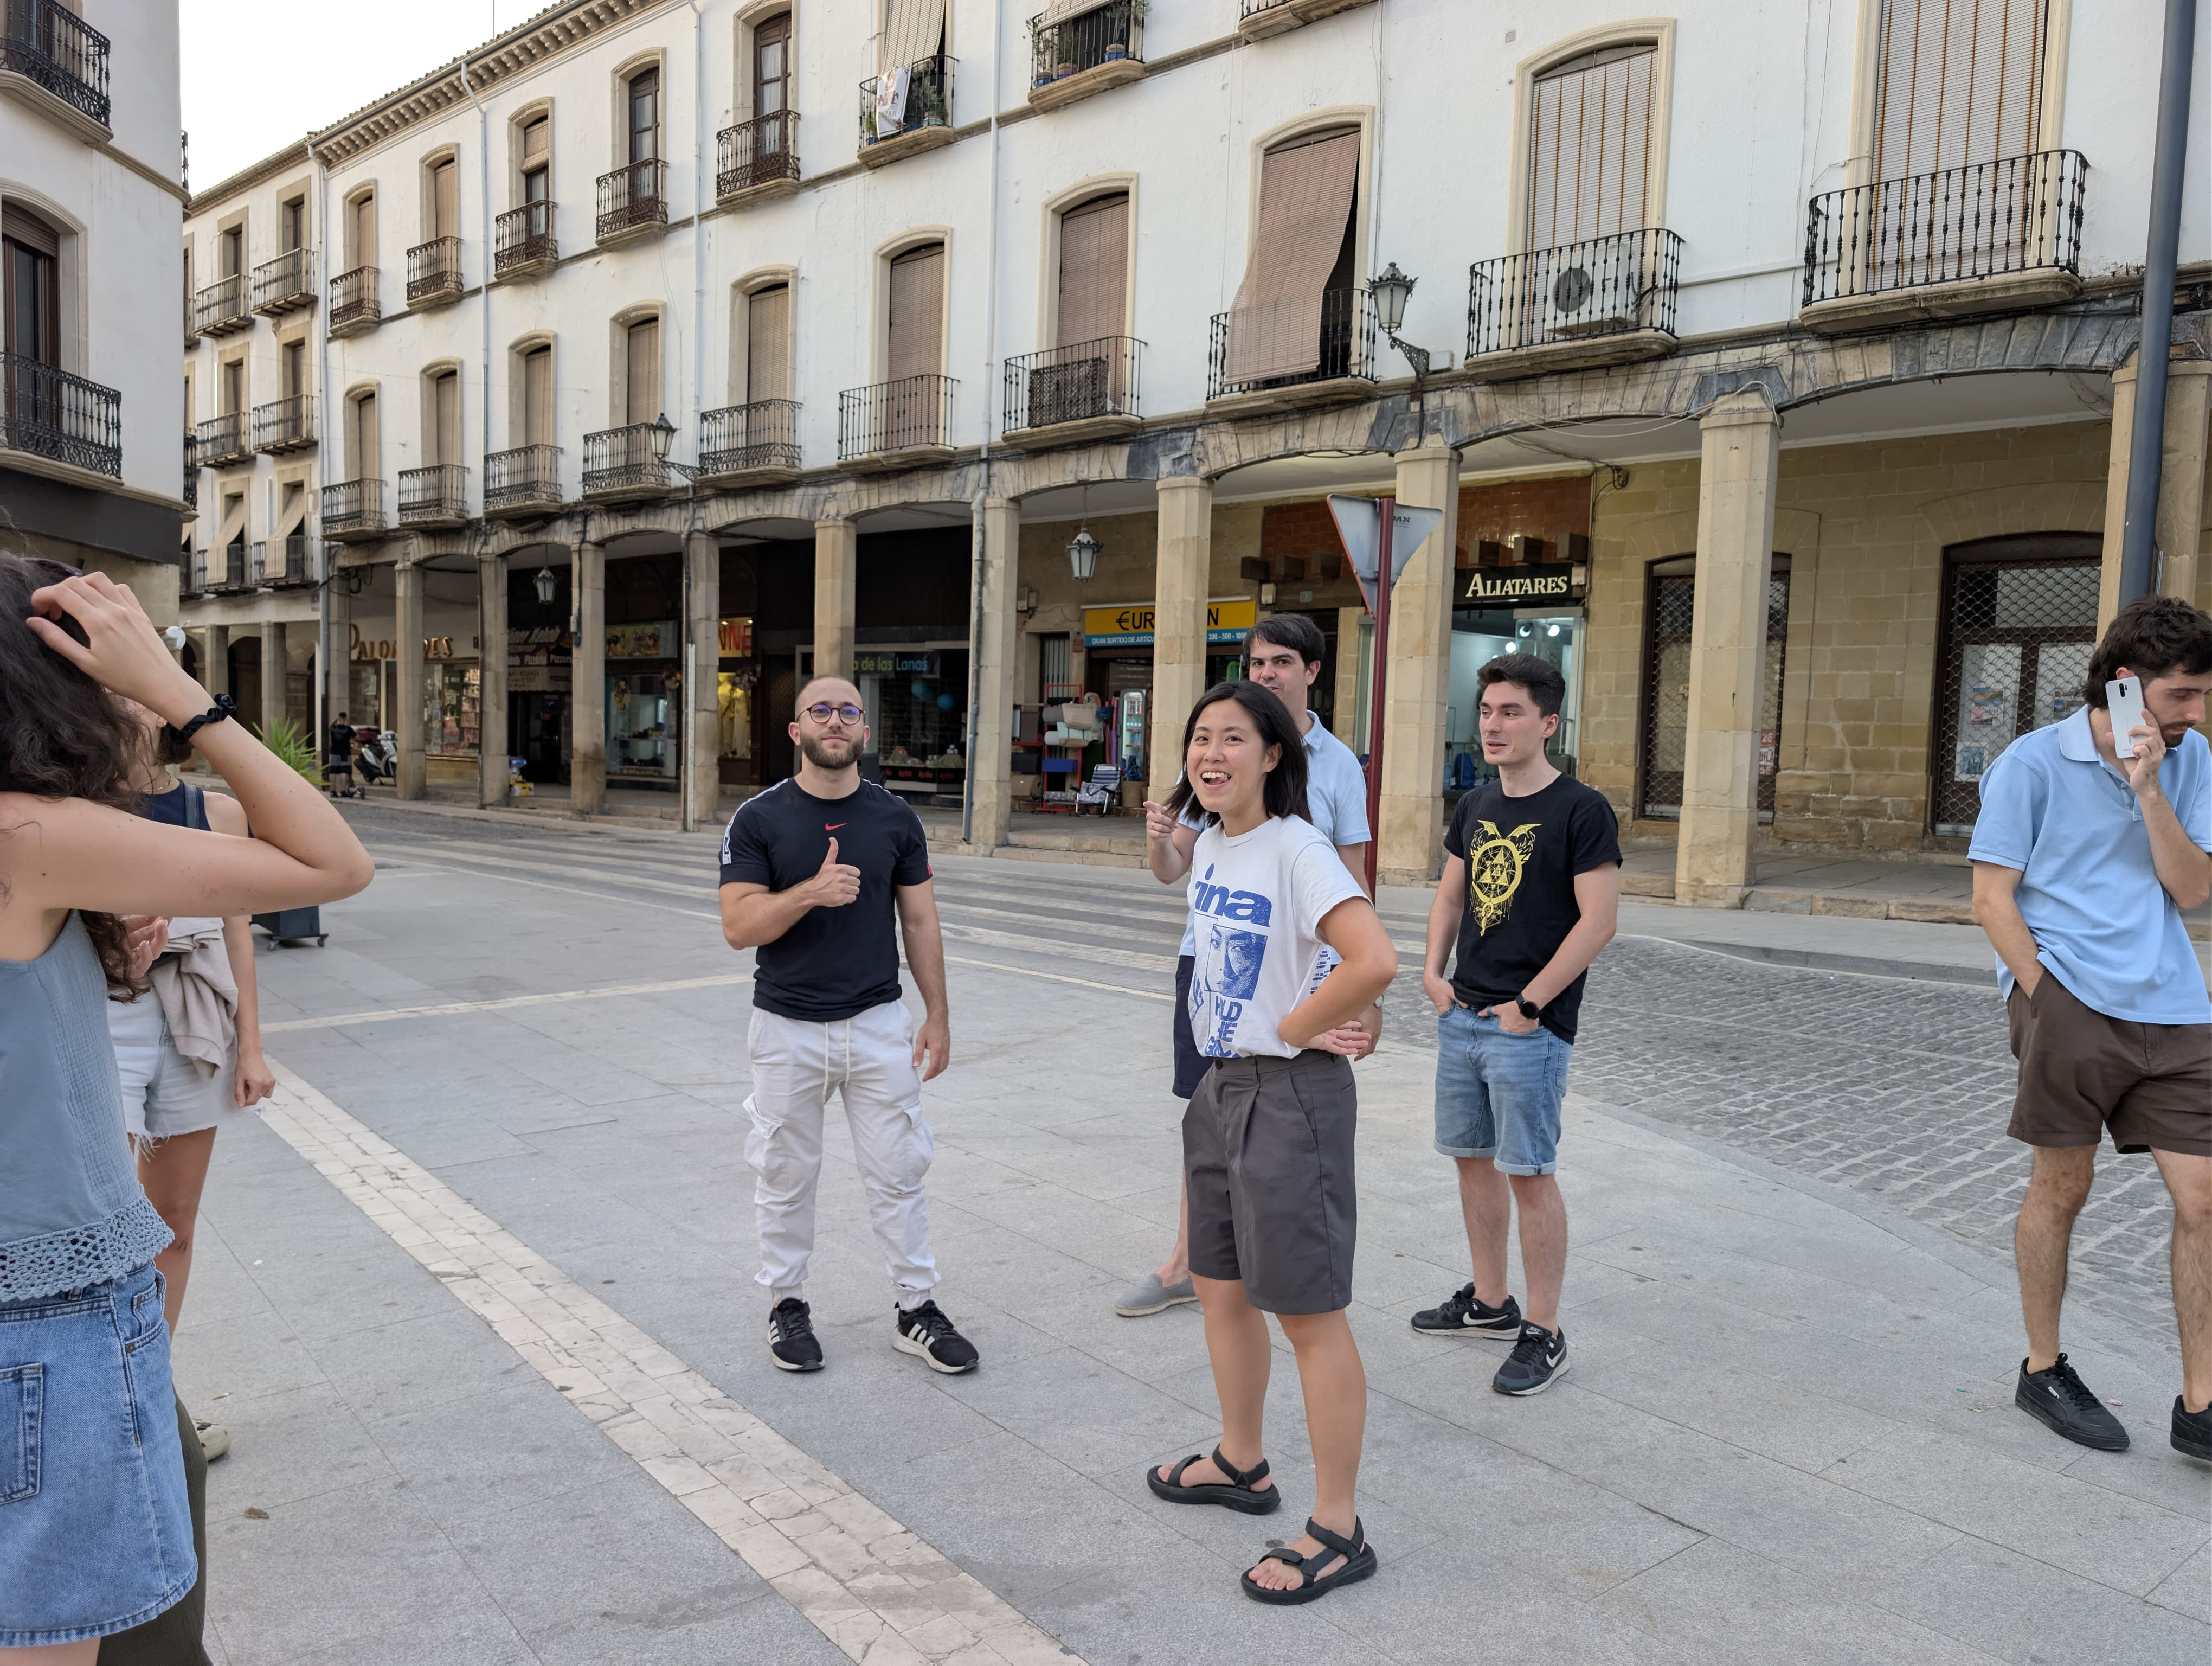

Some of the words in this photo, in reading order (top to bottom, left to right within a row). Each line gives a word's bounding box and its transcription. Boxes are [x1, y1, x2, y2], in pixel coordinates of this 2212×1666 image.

[1136, 635, 1155, 643] ARTÍCU
[861, 658, 875, 671] de
[878, 656, 893, 671] las
[896, 657, 929, 671] Lanas
